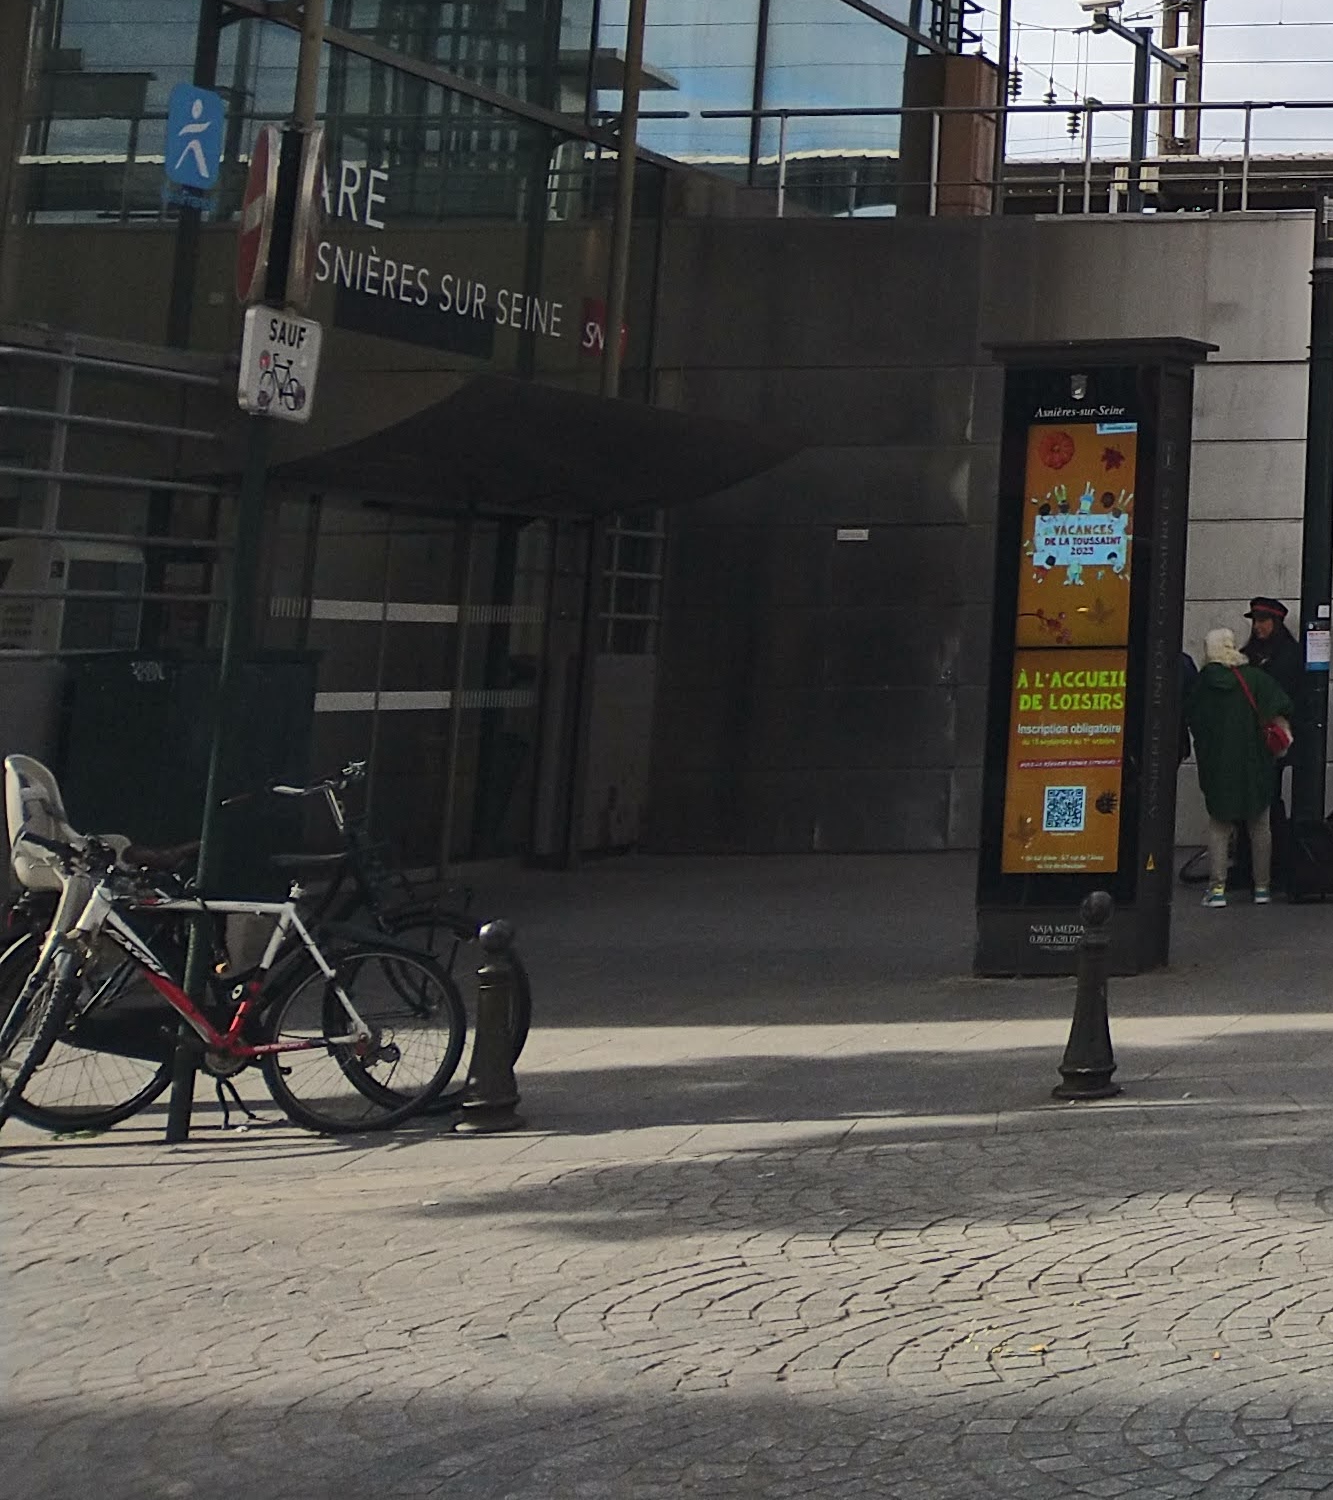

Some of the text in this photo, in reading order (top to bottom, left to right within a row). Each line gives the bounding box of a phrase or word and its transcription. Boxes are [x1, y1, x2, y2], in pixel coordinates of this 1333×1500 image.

[439, 274, 487, 321] SUR
[496, 289, 563, 338] SEINE
[269, 318, 307, 349] SAUF
[1034, 405, 1125, 418] Asnières-sur-Seine
[1053, 524, 1114, 535] VACANCES
[1044, 536, 1122, 546] DE LA TOUSSAINT
[1070, 546, 1094, 556] 2023
[1016, 668, 1127, 688] À L'ACCUEIL
[1019, 693, 1124, 710] DE LOISIRS
[1017, 722, 1121, 737] Inscription obligatoire
[1054, 924, 1086, 934] MEDIA
